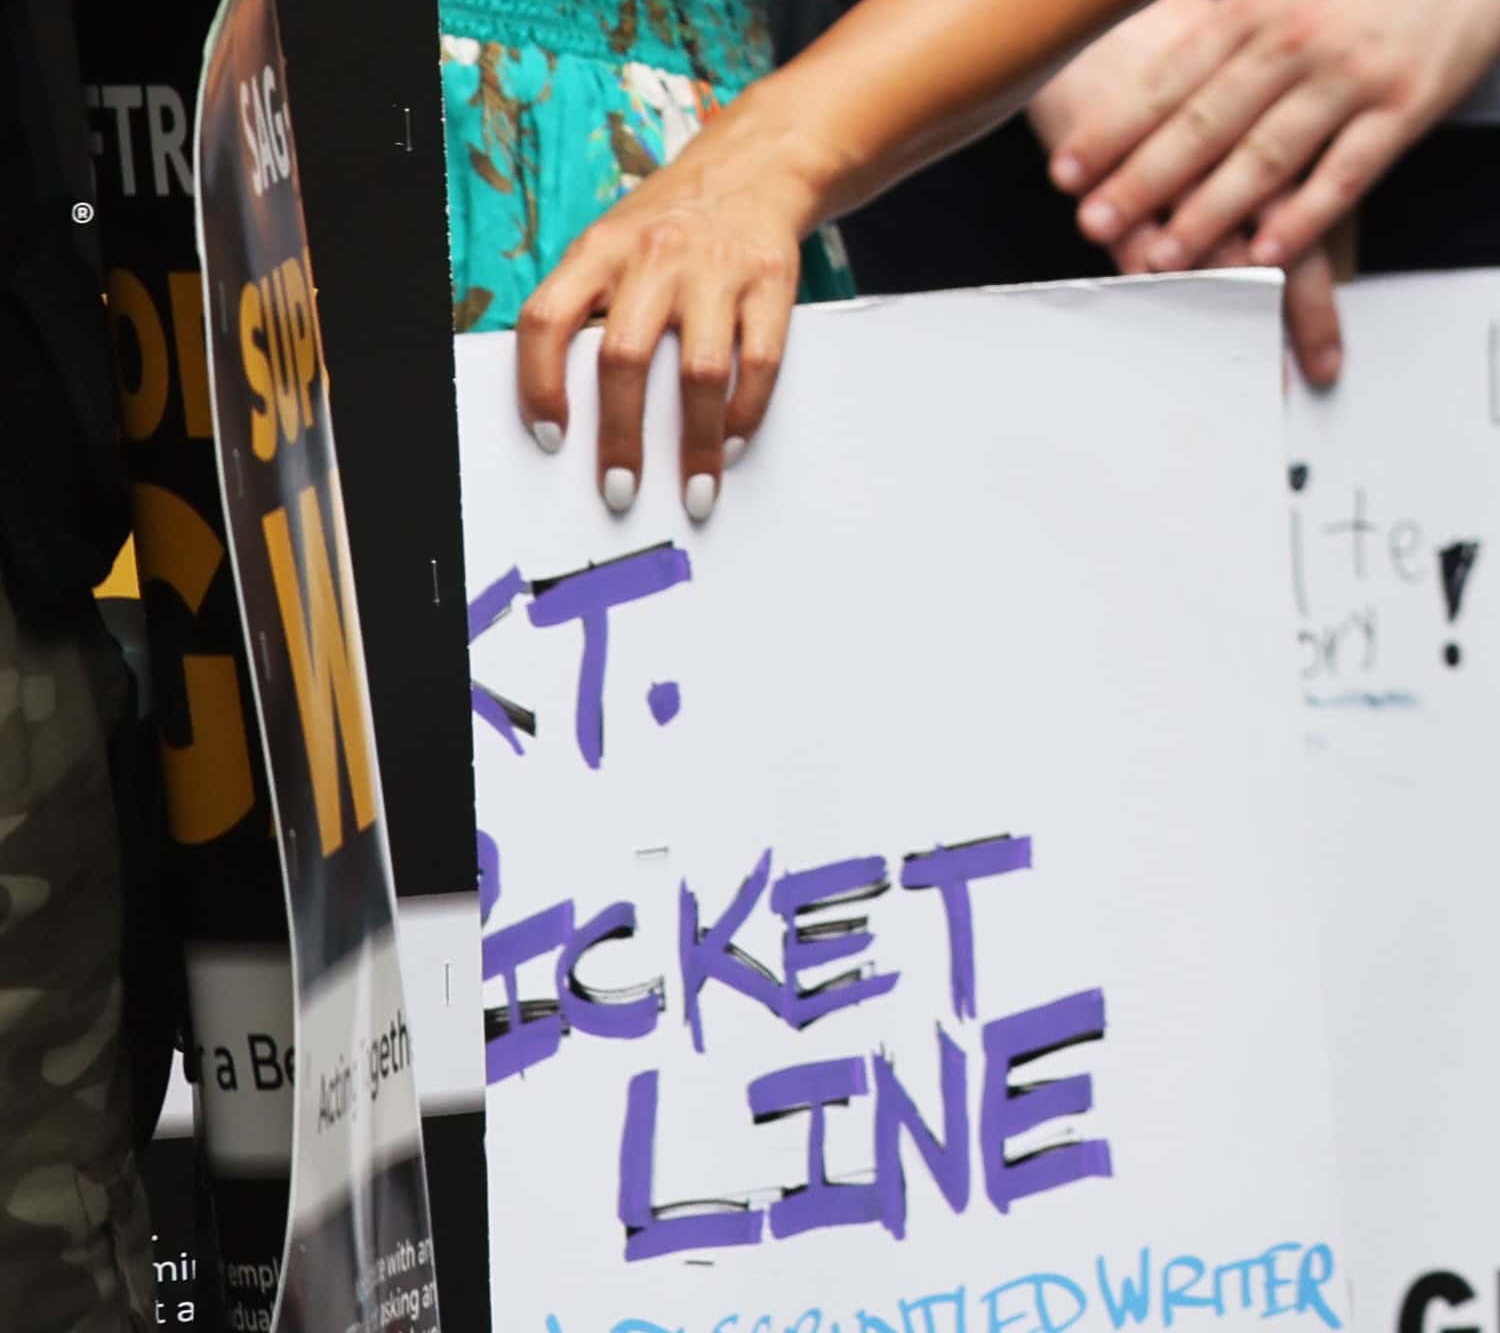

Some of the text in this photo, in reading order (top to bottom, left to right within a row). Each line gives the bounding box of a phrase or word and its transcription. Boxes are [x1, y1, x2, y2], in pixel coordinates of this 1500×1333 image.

[480, 833, 1032, 1084] ICKET
[618, 988, 1114, 1263] LINE
[1097, 1243, 1343, 1332] WRITER
